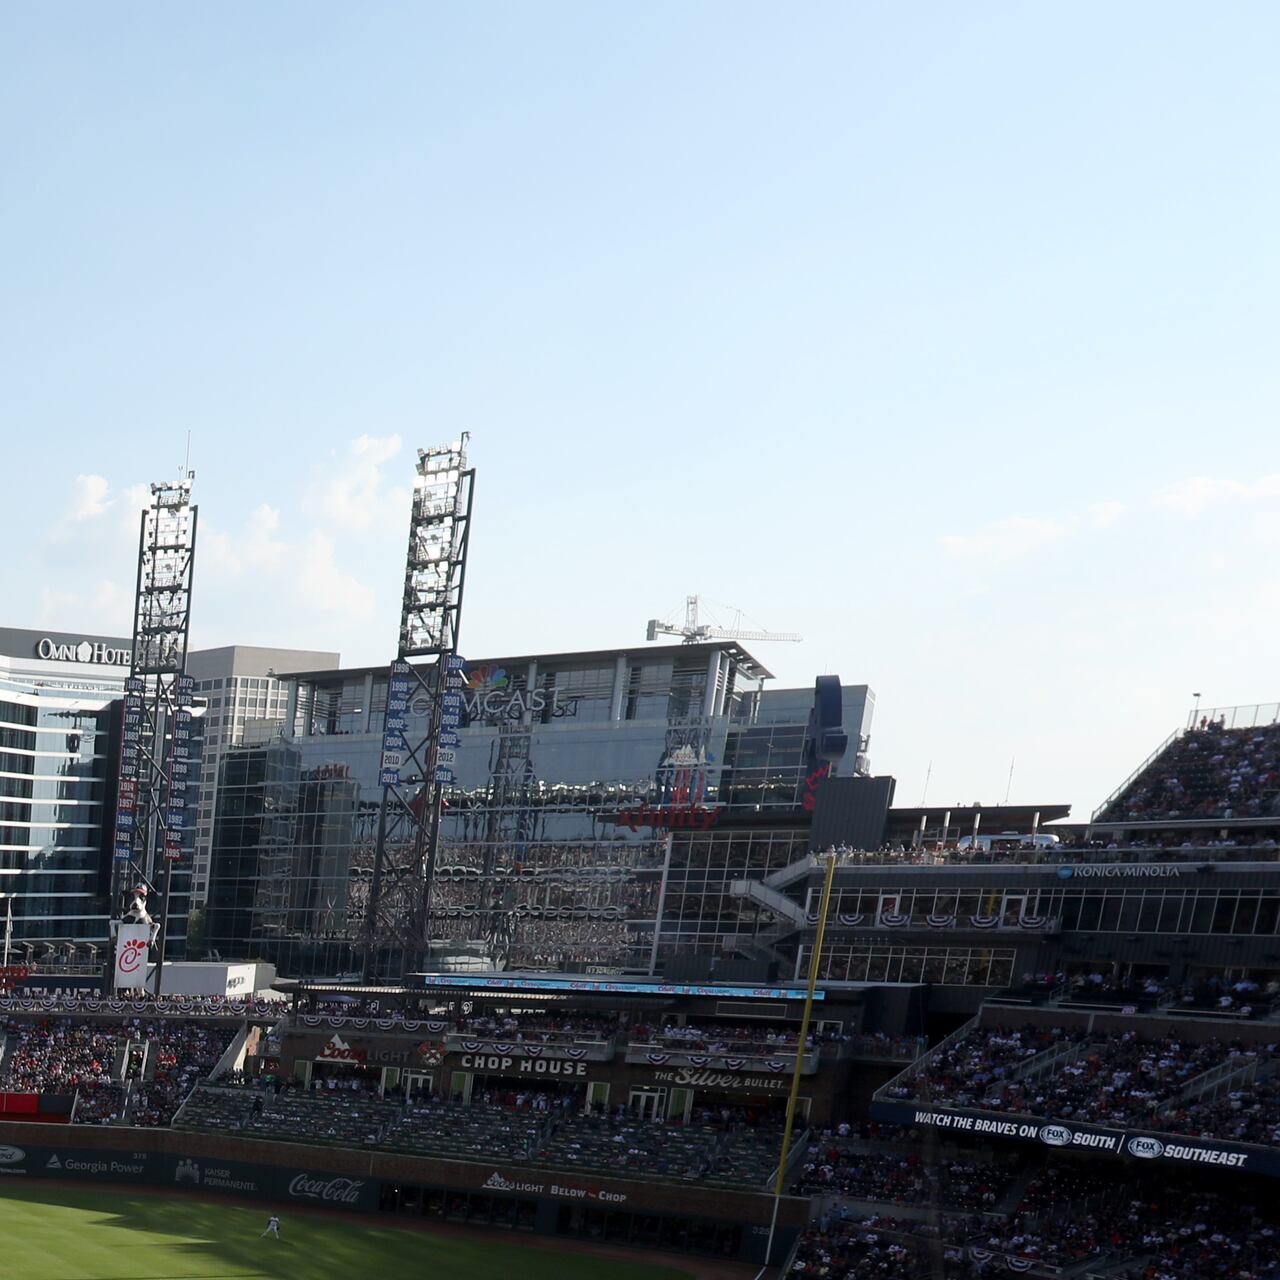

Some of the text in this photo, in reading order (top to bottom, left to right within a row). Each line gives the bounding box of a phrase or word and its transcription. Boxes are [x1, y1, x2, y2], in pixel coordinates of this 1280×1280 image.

[38, 637, 132, 665] OMNI HOTE
[449, 658, 463, 668] 1997
[410, 687, 563, 716] CMCAST
[444, 696, 460, 706] 2001
[388, 718, 403, 728] 2002
[442, 714, 458, 724] 2003
[384, 754, 400, 764] 2010
[438, 752, 454, 762] 2012
[117, 832, 130, 841] 1991
[167, 831, 181, 841] 1992
[1074, 866, 1180, 877] KONICA MINOLTA
[461, 1056, 587, 1075] CHOP HOUSE
[655, 1072, 674, 1081] THE
[675, 1067, 742, 1088] Silver
[914, 1111, 951, 1126] WATCH
[953, 1115, 972, 1130] THE
[974, 1119, 1017, 1136] BRAVES
[1019, 1125, 1038, 1138] ON
[1044, 1127, 1064, 1139] FOX
[1072, 1131, 1116, 1149] SOUTH
[1135, 1140, 1156, 1151] FOX
[1163, 1144, 1248, 1167] SOUTHEAST
[65, 1159, 144, 1174] Georgia Power
[204, 1168, 231, 1177] KAISER
[204, 1177, 256, 1191] PERMANENTE
[289, 1173, 365, 1203] Coca-Cola
[516, 1183, 627, 1202] LIGHT BELOW CHOP
